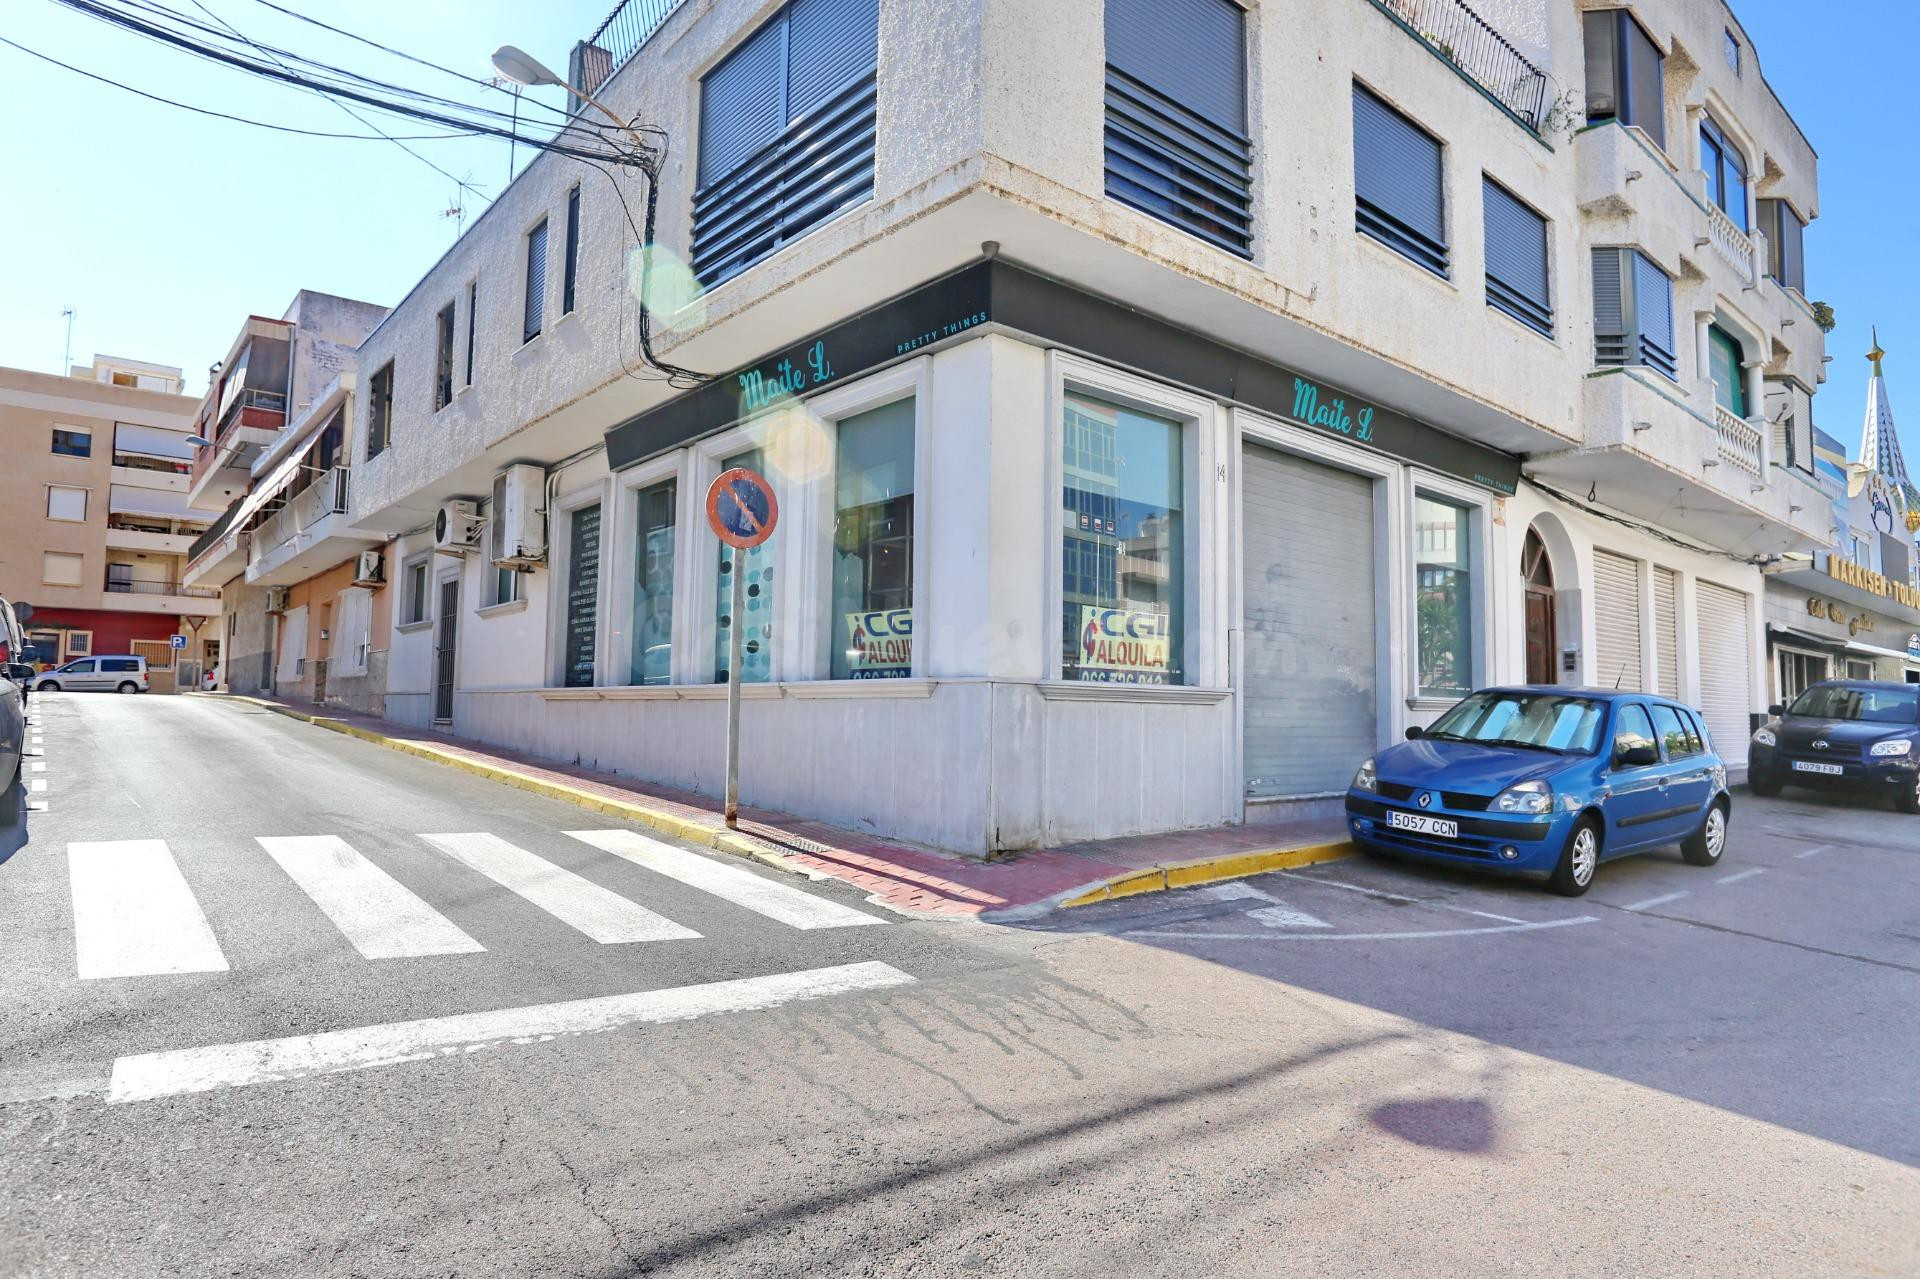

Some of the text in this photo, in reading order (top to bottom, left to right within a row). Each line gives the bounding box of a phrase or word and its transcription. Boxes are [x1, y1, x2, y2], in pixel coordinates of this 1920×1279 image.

[897, 312, 986, 354] PRETTY THINGS
[739, 358, 806, 410] Maite
[1293, 377, 1352, 434] Maite
[1827, 553, 1887, 597] MARKISEN
[1100, 610, 1166, 640] CGI
[1096, 639, 1164, 668] ALQUILA
[1394, 813, 1456, 836] 5057 CCN
